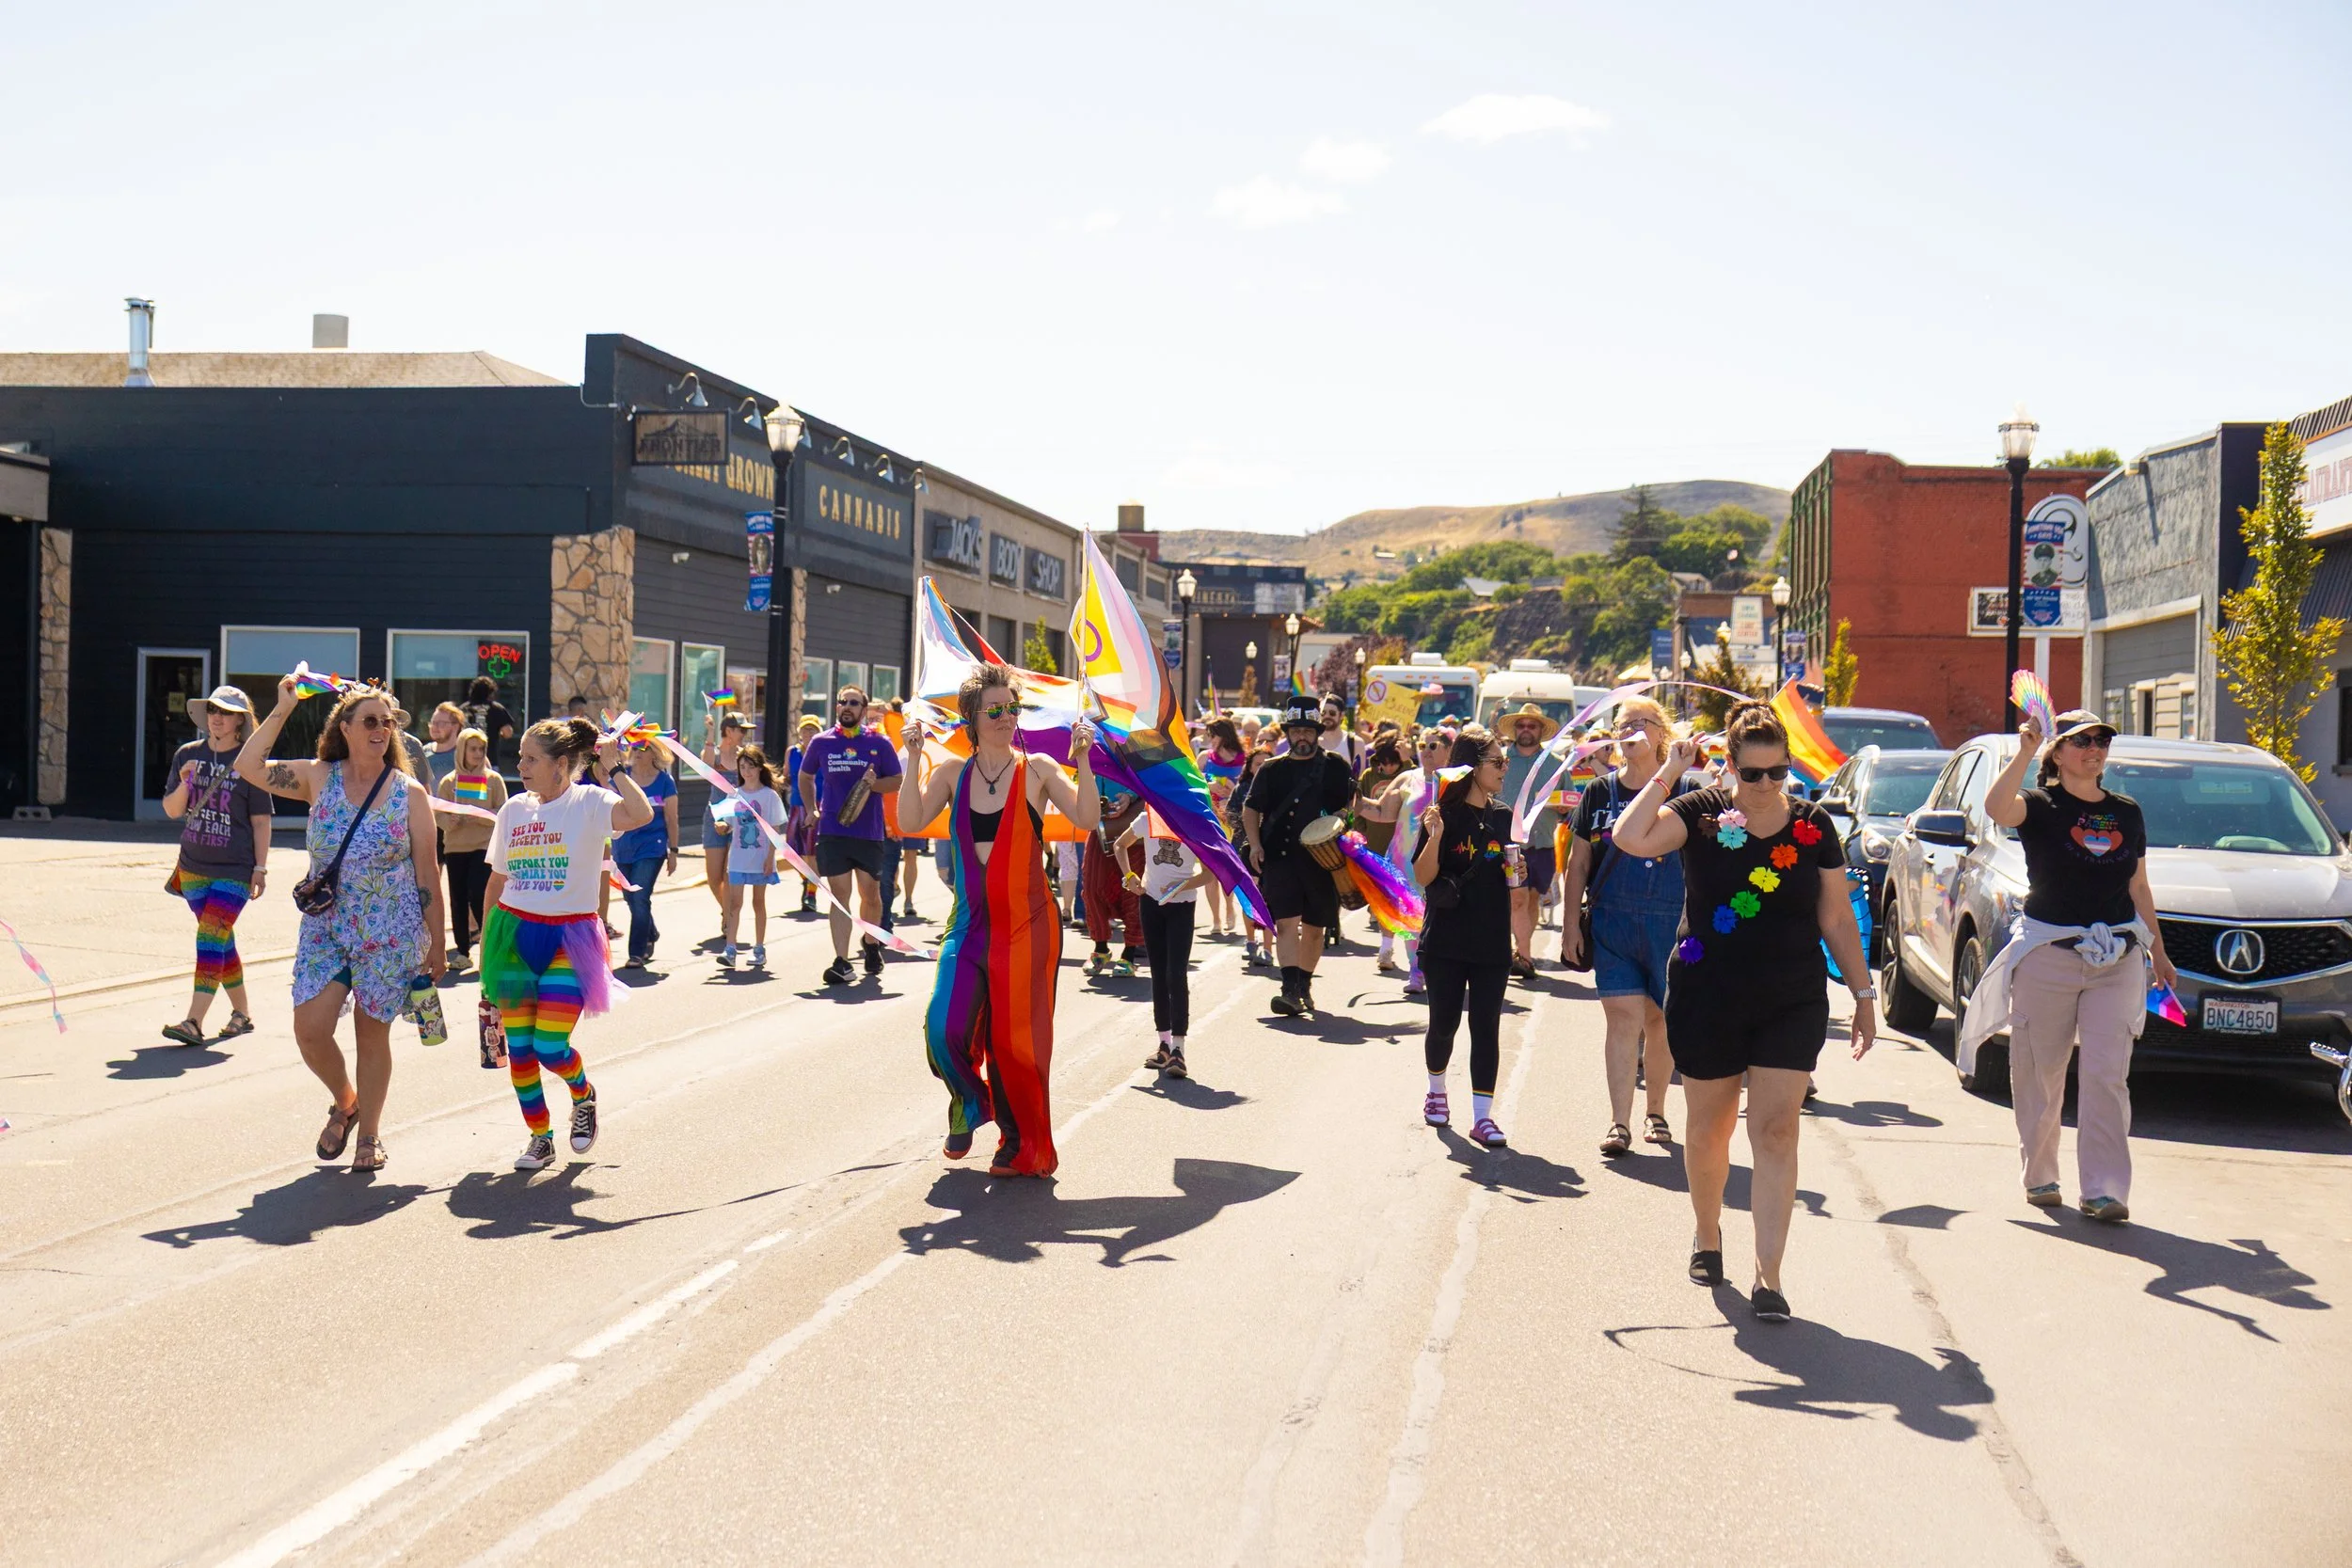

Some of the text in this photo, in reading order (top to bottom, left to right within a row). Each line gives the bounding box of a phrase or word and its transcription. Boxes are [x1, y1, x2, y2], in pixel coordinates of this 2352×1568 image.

[726, 452, 774, 500] GROWN
[819, 484, 900, 540] CANNABIS
[996, 537, 1024, 580] BODY
[1037, 553, 1061, 592] SHOP
[478, 644, 521, 663] OPEN
[219, 813, 231, 825] TO
[205, 821, 231, 837] EACH
[512, 822, 546, 837] SEE YOU
[201, 834, 230, 847] FIRST
[509, 832, 562, 847] ACCEPT YOU
[548, 845, 567, 856] YOU
[508, 857, 569, 871] SUPPORT YOU
[548, 869, 566, 879] YOU
[532, 880, 553, 891] YOU
[2208, 1001, 2250, 1009] WASHINGTON
[2207, 1007, 2274, 1029] BNC4850
